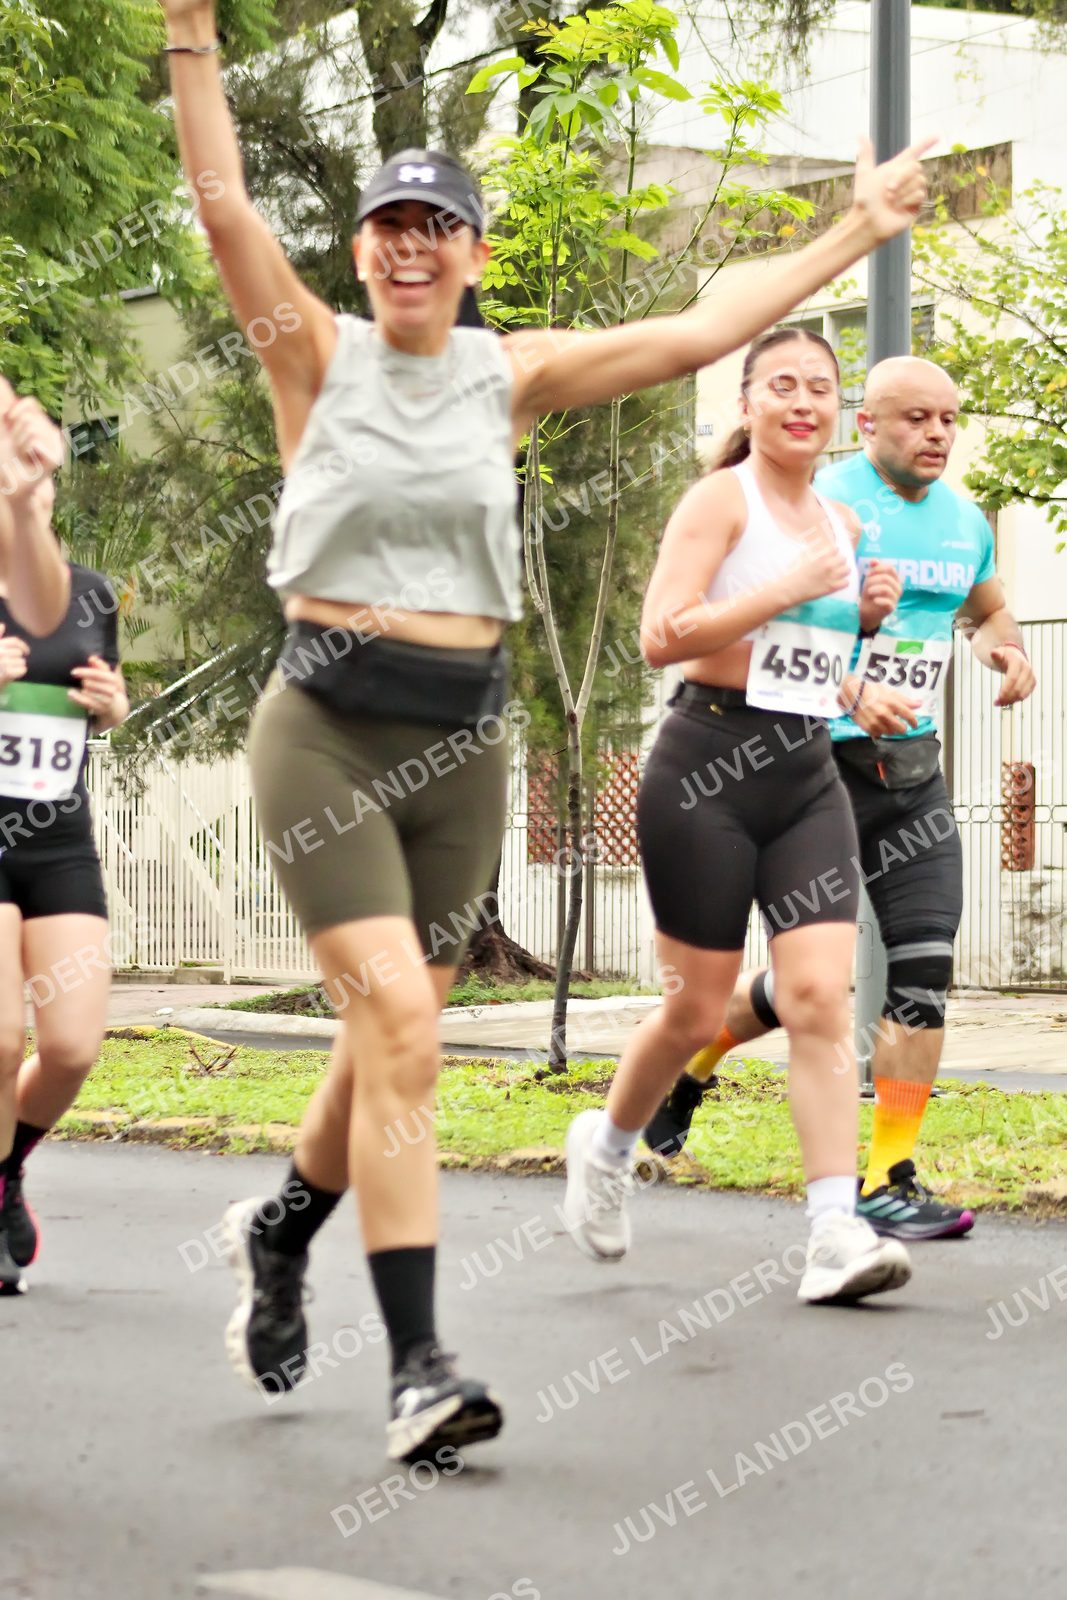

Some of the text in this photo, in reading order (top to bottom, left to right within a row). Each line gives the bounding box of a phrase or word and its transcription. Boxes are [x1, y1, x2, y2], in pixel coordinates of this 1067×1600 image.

[761, 644, 843, 687] 4590
[864, 652, 943, 691] 5367
[0, 734, 72, 771] 318
